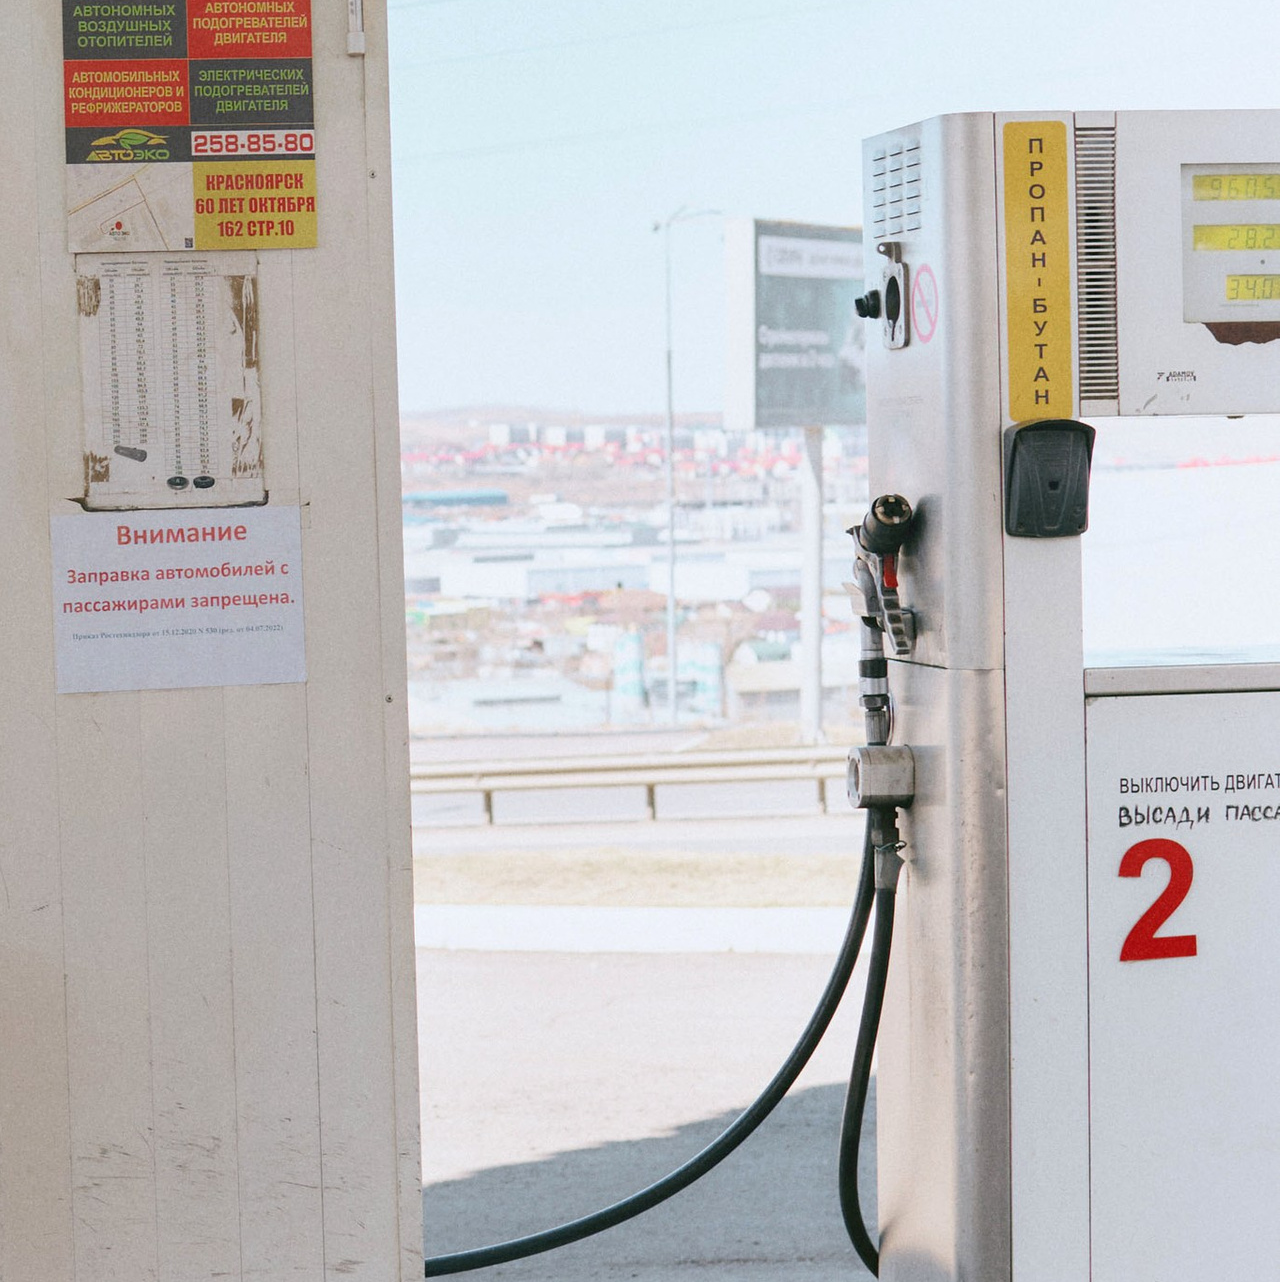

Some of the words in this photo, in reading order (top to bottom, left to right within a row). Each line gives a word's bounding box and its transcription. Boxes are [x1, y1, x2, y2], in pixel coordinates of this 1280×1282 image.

[73, 5, 175, 17] АВТОНОМНЫХ
[205, 2, 295, 14] АВТОНОМНЫХ
[78, 21, 171, 33] ВОЗДУШНЫХ
[193, 15, 307, 30] ПОДОГРЕВАТЕЛЕЙ
[78, 34, 172, 48] ОТОПИТЕЛЕЙ
[214, 33, 287, 46] ДВИГАТЕЛЯ
[72, 71, 180, 83] АВТОМОБИЛЬНЫХ
[199, 69, 303, 81] ЭЛЕКТРИЧЕСКИХ
[69, 87, 173, 100] КОНДИЦИОНЕРОВ
[176, 87, 183, 97] И
[194, 83, 309, 97] ПОДОГРЕВАТЕЛЕЙ
[71, 102, 182, 114] РЕФРИЖЕРАТОРОВ
[216, 100, 288, 113] ДВИГАТЕЛЯ
[86, 148, 169, 161] АВТОЭКО
[206, 174, 303, 190] КРАСНОЯРСК
[196, 198, 214, 214] 60
[219, 198, 244, 213] ЛЕТ
[249, 197, 315, 213] ОКТЯБРЯ
[218, 221, 243, 236] 162
[247, 220, 294, 236] СТР.10
[117, 525, 247, 545] Внимание
[67, 569, 150, 585] Заправка
[156, 561, 275, 580] автомобилей
[280, 564, 288, 575] с
[63, 598, 185, 613] пассажирами
[191, 591, 295, 609] запрещена.
[1120, 775, 1220, 794] ВЫКЛЮЧИТЬ
[1224, 773, 1280, 793] ДВИГАТ
[1118, 804, 1210, 830] ВЫСАДИ
[1118, 838, 1197, 962] 2
